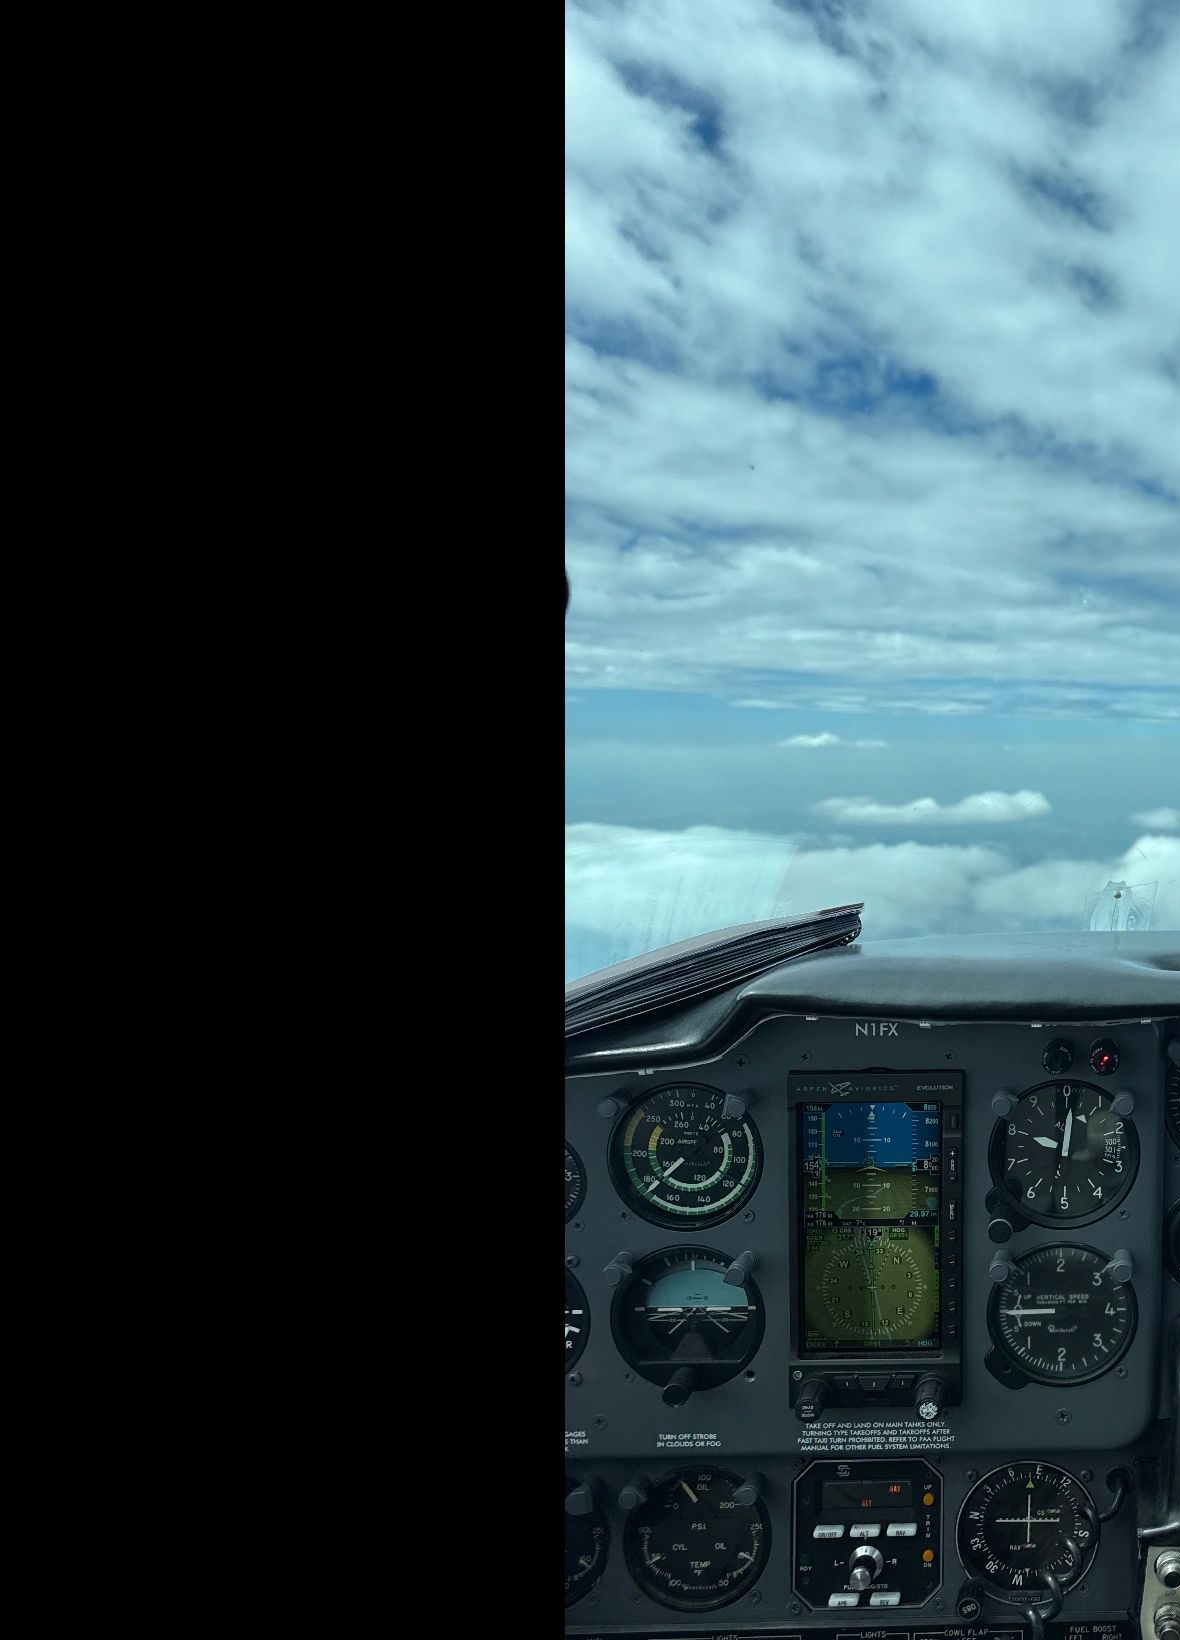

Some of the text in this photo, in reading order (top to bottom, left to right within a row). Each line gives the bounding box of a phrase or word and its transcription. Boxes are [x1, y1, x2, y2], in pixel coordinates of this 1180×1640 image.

[855, 1023, 899, 1037] N1FX
[1008, 1124, 1016, 1135] 8
[1115, 1122, 1123, 1134] 2
[1008, 1159, 1016, 1170] 7
[1114, 1161, 1122, 1172] 3
[1027, 1187, 1035, 1198] 6
[1093, 1187, 1102, 1199] 4
[1061, 1198, 1069, 1209] 5
[1057, 1259, 1064, 1272] 2
[1092, 1272, 1102, 1286] 3
[1105, 1302, 1116, 1316] 4
[1092, 1334, 1102, 1347] 3
